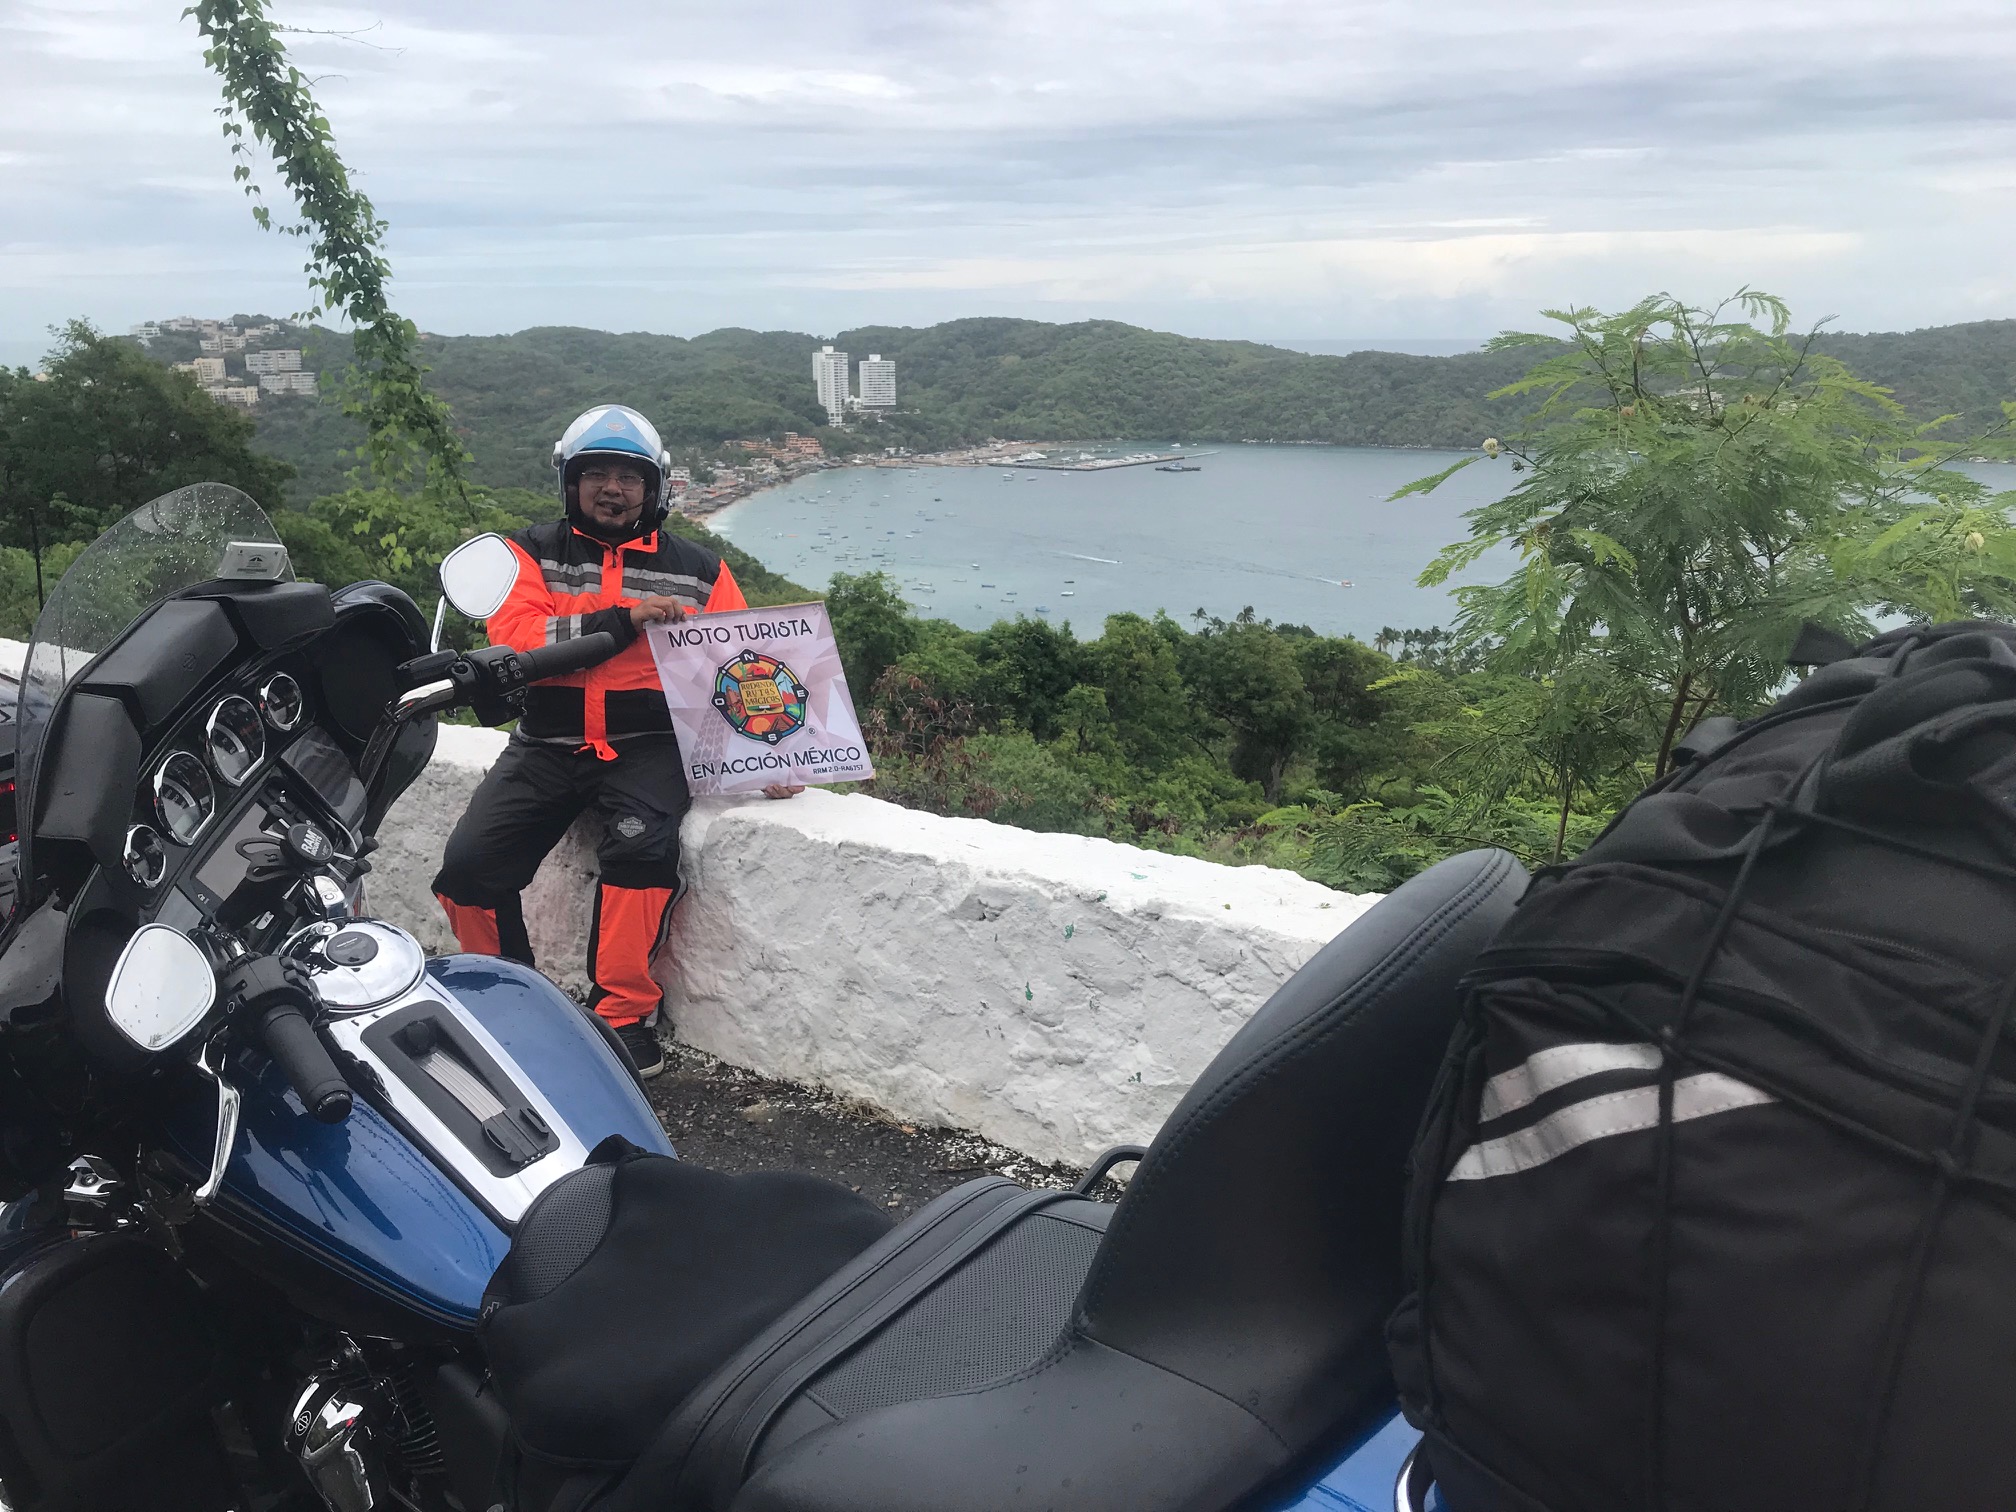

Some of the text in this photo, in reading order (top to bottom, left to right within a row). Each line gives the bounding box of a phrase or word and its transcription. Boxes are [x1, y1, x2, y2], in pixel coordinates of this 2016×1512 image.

[667, 619, 813, 648] MOTO TURISTA
[744, 653, 755, 661] N
[796, 689, 806, 698] E
[714, 698, 725, 706] O
[768, 734, 777, 742] S
[692, 747, 861, 779] EN ACCIÓN MÉXICO
[300, 828, 318, 853] RAM
